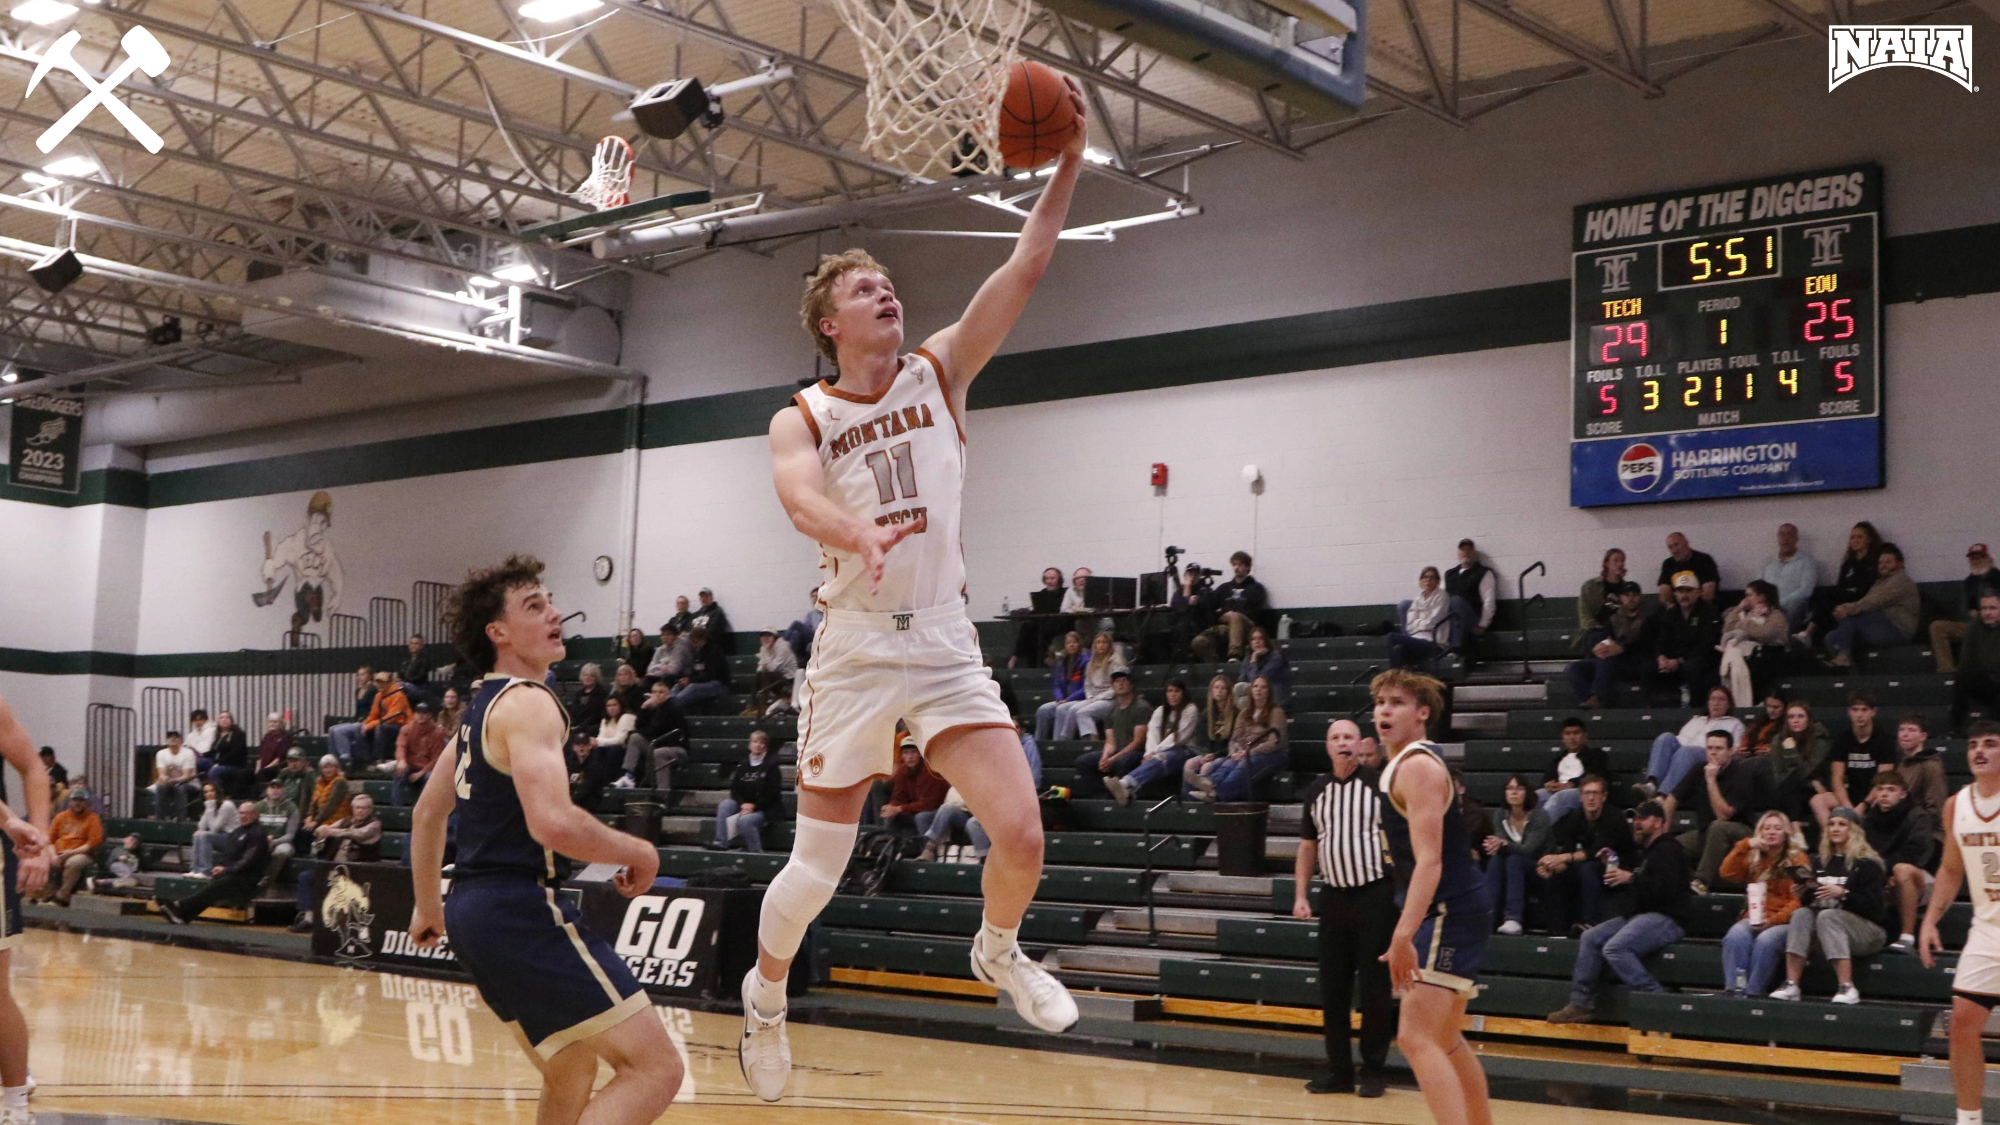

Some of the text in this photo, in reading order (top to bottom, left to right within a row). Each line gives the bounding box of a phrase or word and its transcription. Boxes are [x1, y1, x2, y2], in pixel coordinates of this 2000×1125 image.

[1583, 172, 1865, 243] HOME OF THE DIGGERS
[1689, 235, 1774, 281] 5:51
[1805, 273, 1838, 295] EOU
[1602, 297, 1642, 319] TECH
[1698, 296, 1741, 313] PERIOD
[1720, 318, 1728, 345] 1
[1803, 298, 1855, 342] 25
[1601, 322, 1648, 363] 29
[1819, 343, 1861, 359] FOULS
[1586, 366, 1624, 384] FOULS
[1677, 353, 1761, 375] PLAYER FOUL
[1834, 361, 1855, 393] 5
[1778, 368, 1798, 395] 4
[1599, 384, 1618, 415] 5
[1642, 380, 1660, 411] 3
[1819, 400, 1861, 415] SCORE
[1586, 420, 1623, 436] SCORE
[1698, 409, 1741, 426] MATCH
[829, 403, 935, 460] MONTANA
[21, 448, 65, 470] 2023
[1622, 462, 1657, 475] PEPS
[1671, 441, 1798, 469] HARRINGTON
[865, 441, 918, 505] 11
[1673, 461, 1791, 480] BOTTLING COMPANY
[614, 894, 706, 961] GO
